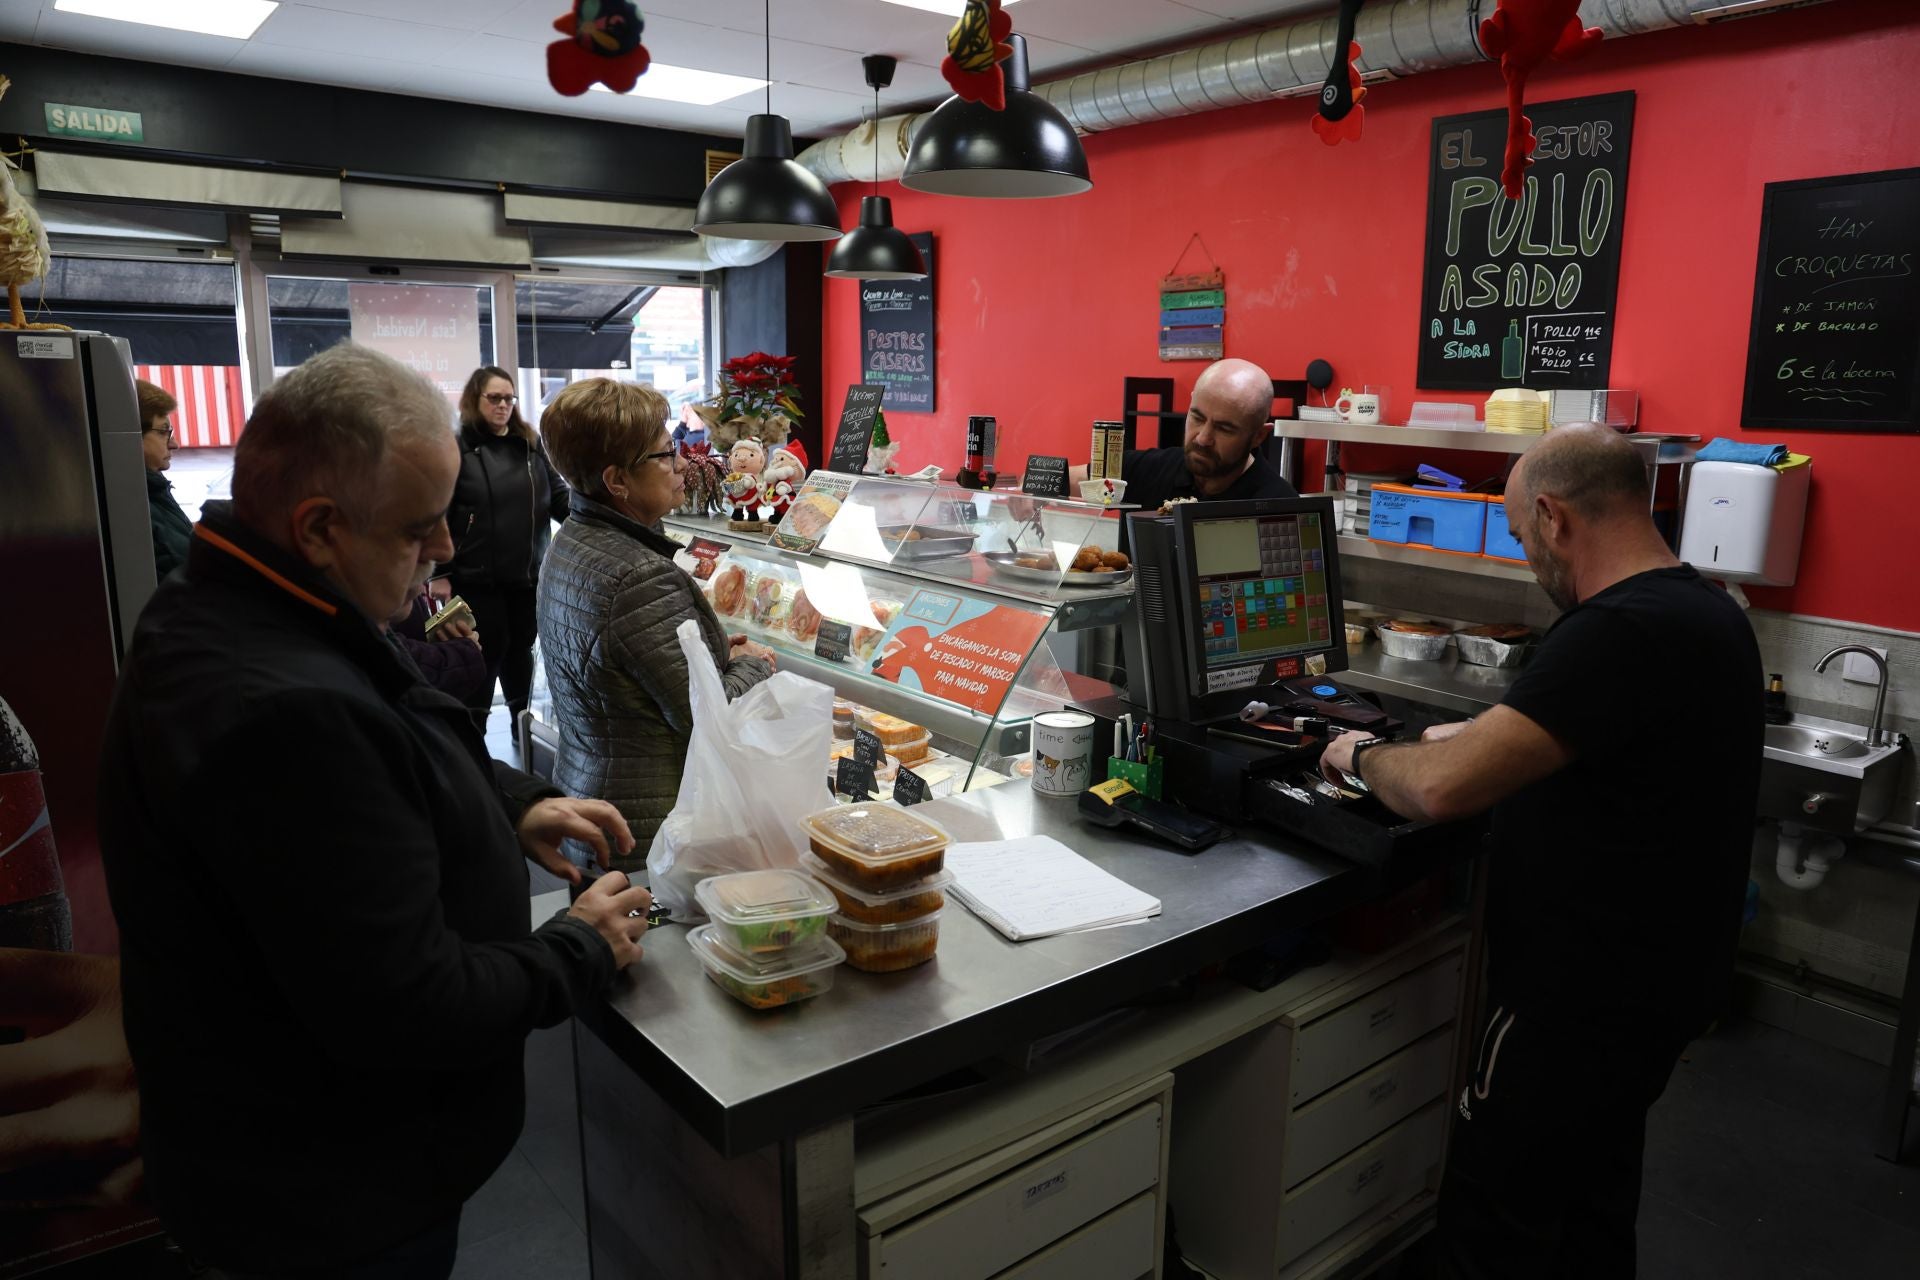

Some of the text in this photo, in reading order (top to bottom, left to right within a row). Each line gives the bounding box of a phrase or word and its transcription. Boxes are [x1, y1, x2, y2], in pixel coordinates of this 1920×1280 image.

[51, 108, 133, 135] SALIDA
[1440, 121, 1613, 169] EL EJOR
[1446, 168, 1613, 257] POLLO
[1817, 216, 1874, 239] HAY
[1775, 253, 1913, 278] CROQUETAS
[1439, 262, 1582, 312] ASADO
[1796, 301, 1812, 313] DE
[1431, 318, 1476, 338] A LA
[1544, 325, 1581, 338] POLLO
[1792, 321, 1879, 332] DE BACALAO
[1541, 358, 1572, 368] POLLO
[1842, 361, 1897, 380] docena
[929, 650, 1015, 682] DE PESCADO Y MARISCO
[987, 646, 1000, 659] LA
[999, 650, 1021, 666] SOPA
[933, 670, 989, 695] PARA NAVIDAD
[1039, 729, 1065, 744] time
[898, 768, 920, 787] PASTEL
